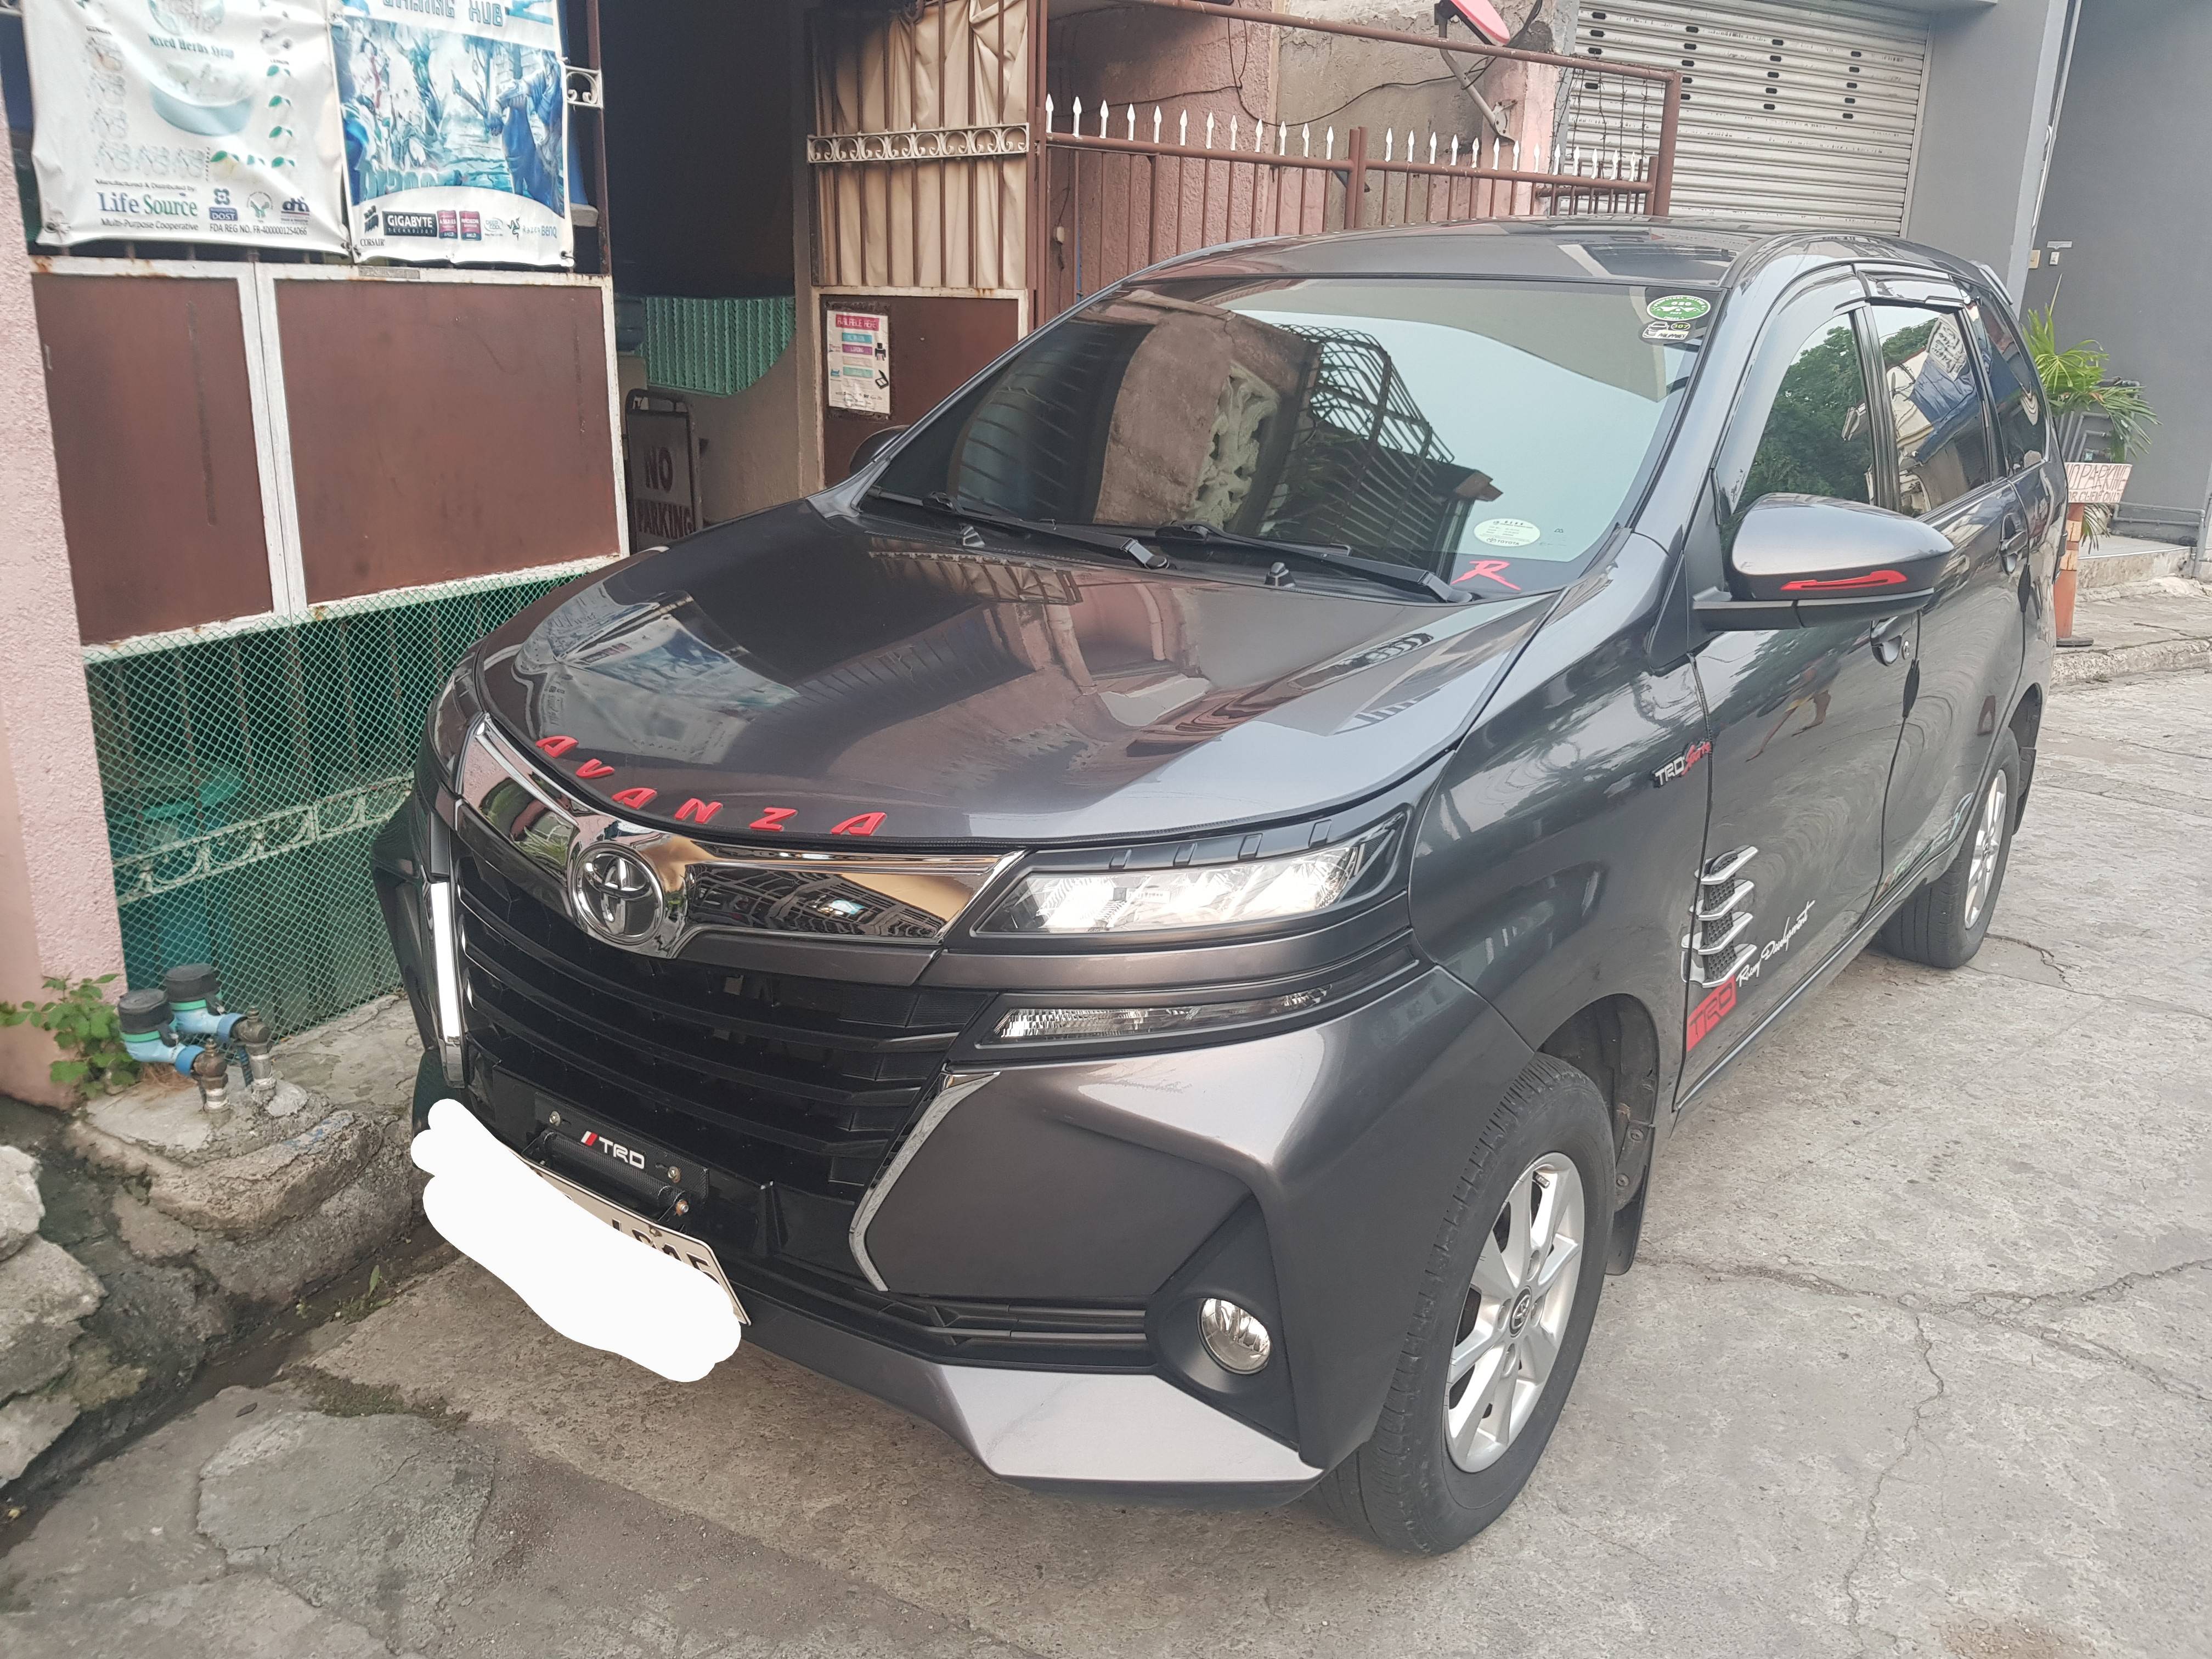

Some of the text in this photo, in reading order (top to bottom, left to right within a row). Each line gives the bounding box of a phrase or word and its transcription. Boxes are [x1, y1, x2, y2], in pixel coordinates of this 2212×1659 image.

[383, 0, 503, 27] MING HUB
[97, 192, 198, 217] Life Source
[155, 221, 199, 231] Cooperative
[210, 223, 223, 232] FDA
[224, 224, 238, 233] REG
[387, 215, 433, 228] GIGABYTE
[360, 238, 385, 247] CORSAIR
[643, 445, 673, 493] NO
[1450, 559, 1522, 591] R
[1655, 756, 1685, 786] TRD
[535, 736, 887, 836] AVANZA
[599, 1136, 645, 1170] TRD
